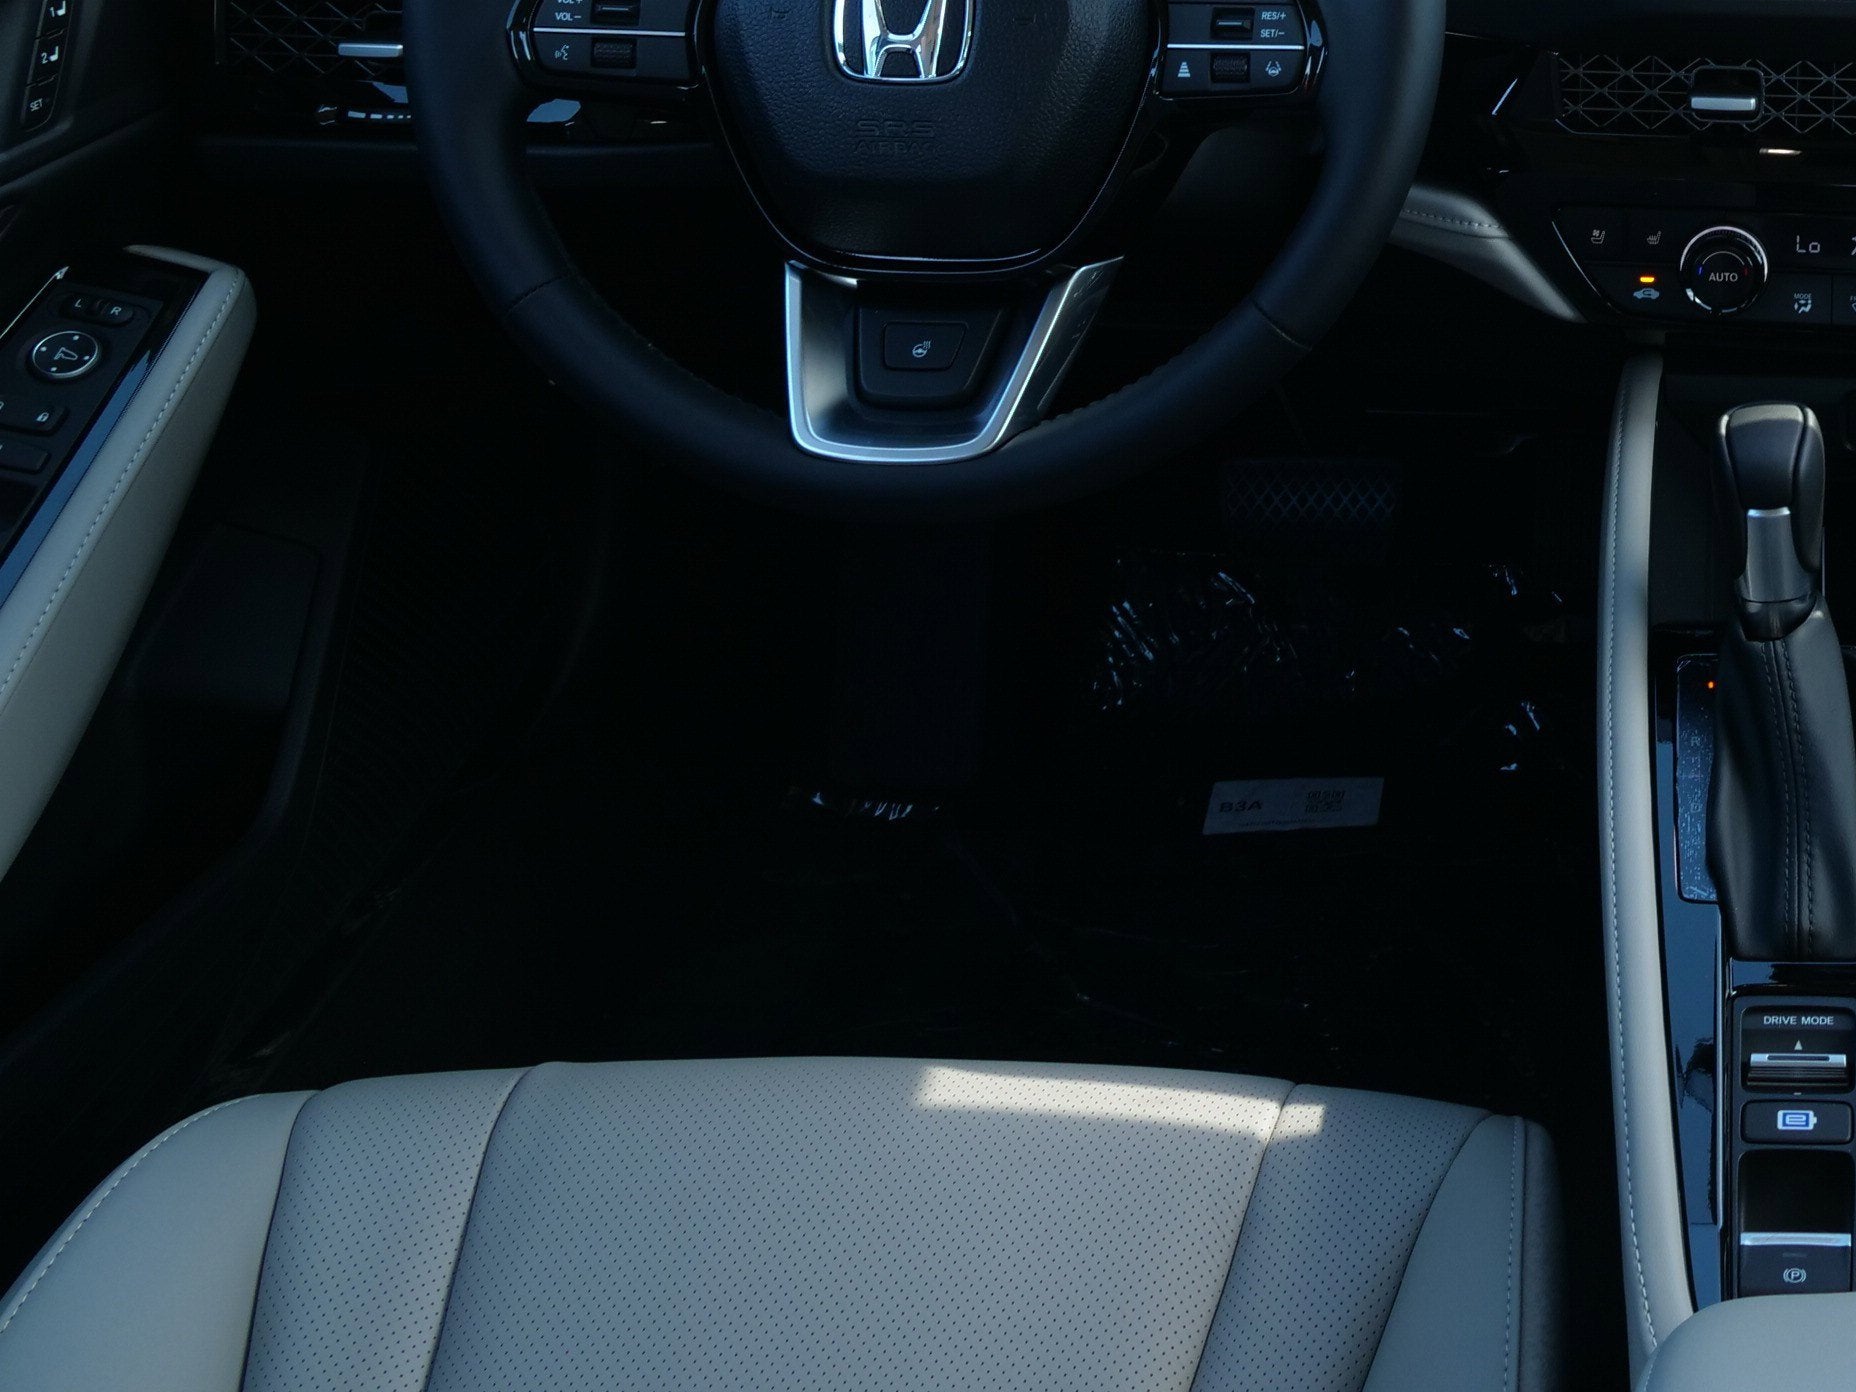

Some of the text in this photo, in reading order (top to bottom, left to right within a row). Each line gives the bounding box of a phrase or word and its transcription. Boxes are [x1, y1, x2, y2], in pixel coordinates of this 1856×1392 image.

[29, 98, 44, 112] SET
[1708, 272, 1738, 283] AUTO
[74, 298, 83, 308] L
[110, 306, 122, 317] R
[1763, 1015, 1835, 1026] DRIVE MODE
